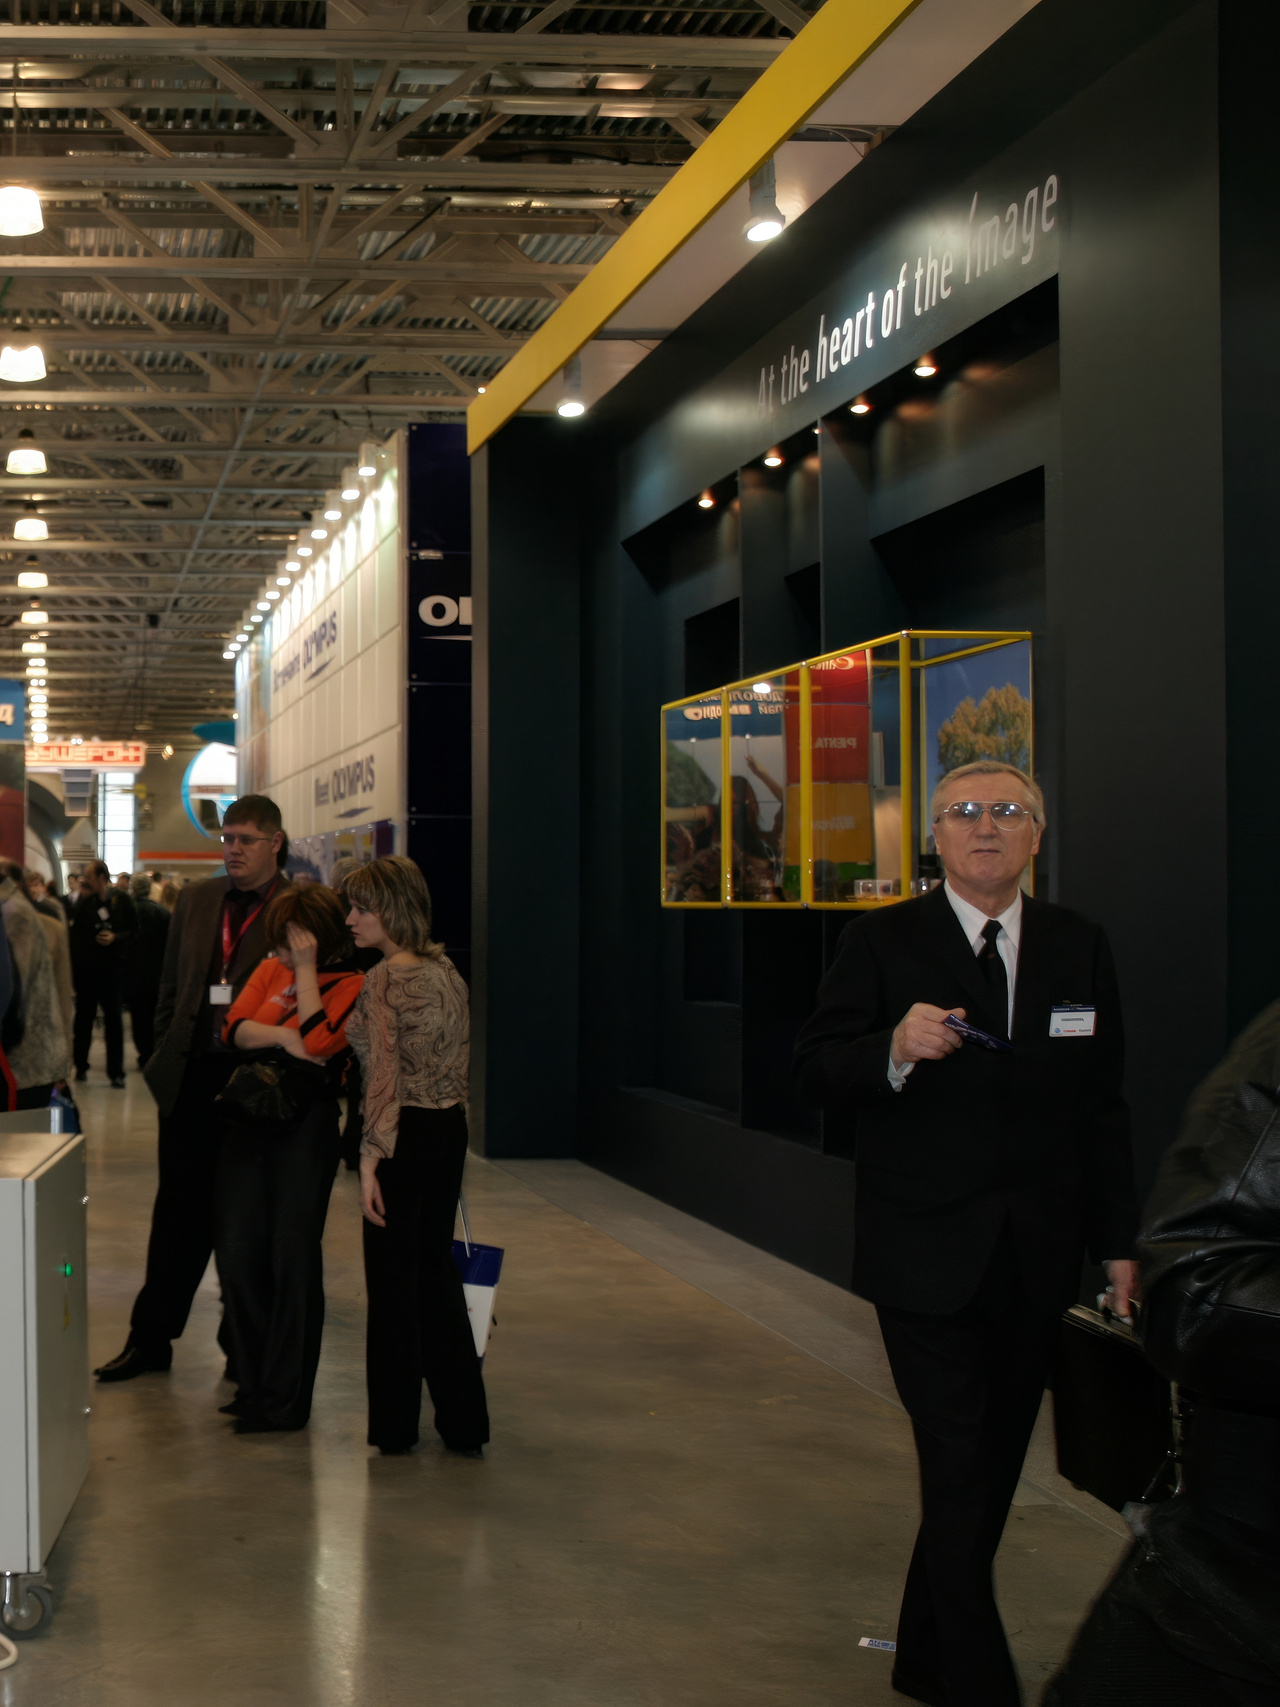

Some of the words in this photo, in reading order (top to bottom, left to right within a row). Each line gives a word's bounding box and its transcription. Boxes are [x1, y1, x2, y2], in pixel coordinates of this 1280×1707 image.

[757, 363, 776, 418] At
[781, 344, 810, 406] the
[816, 291, 876, 383] heart
[880, 262, 908, 339] of
[914, 245, 954, 318] the
